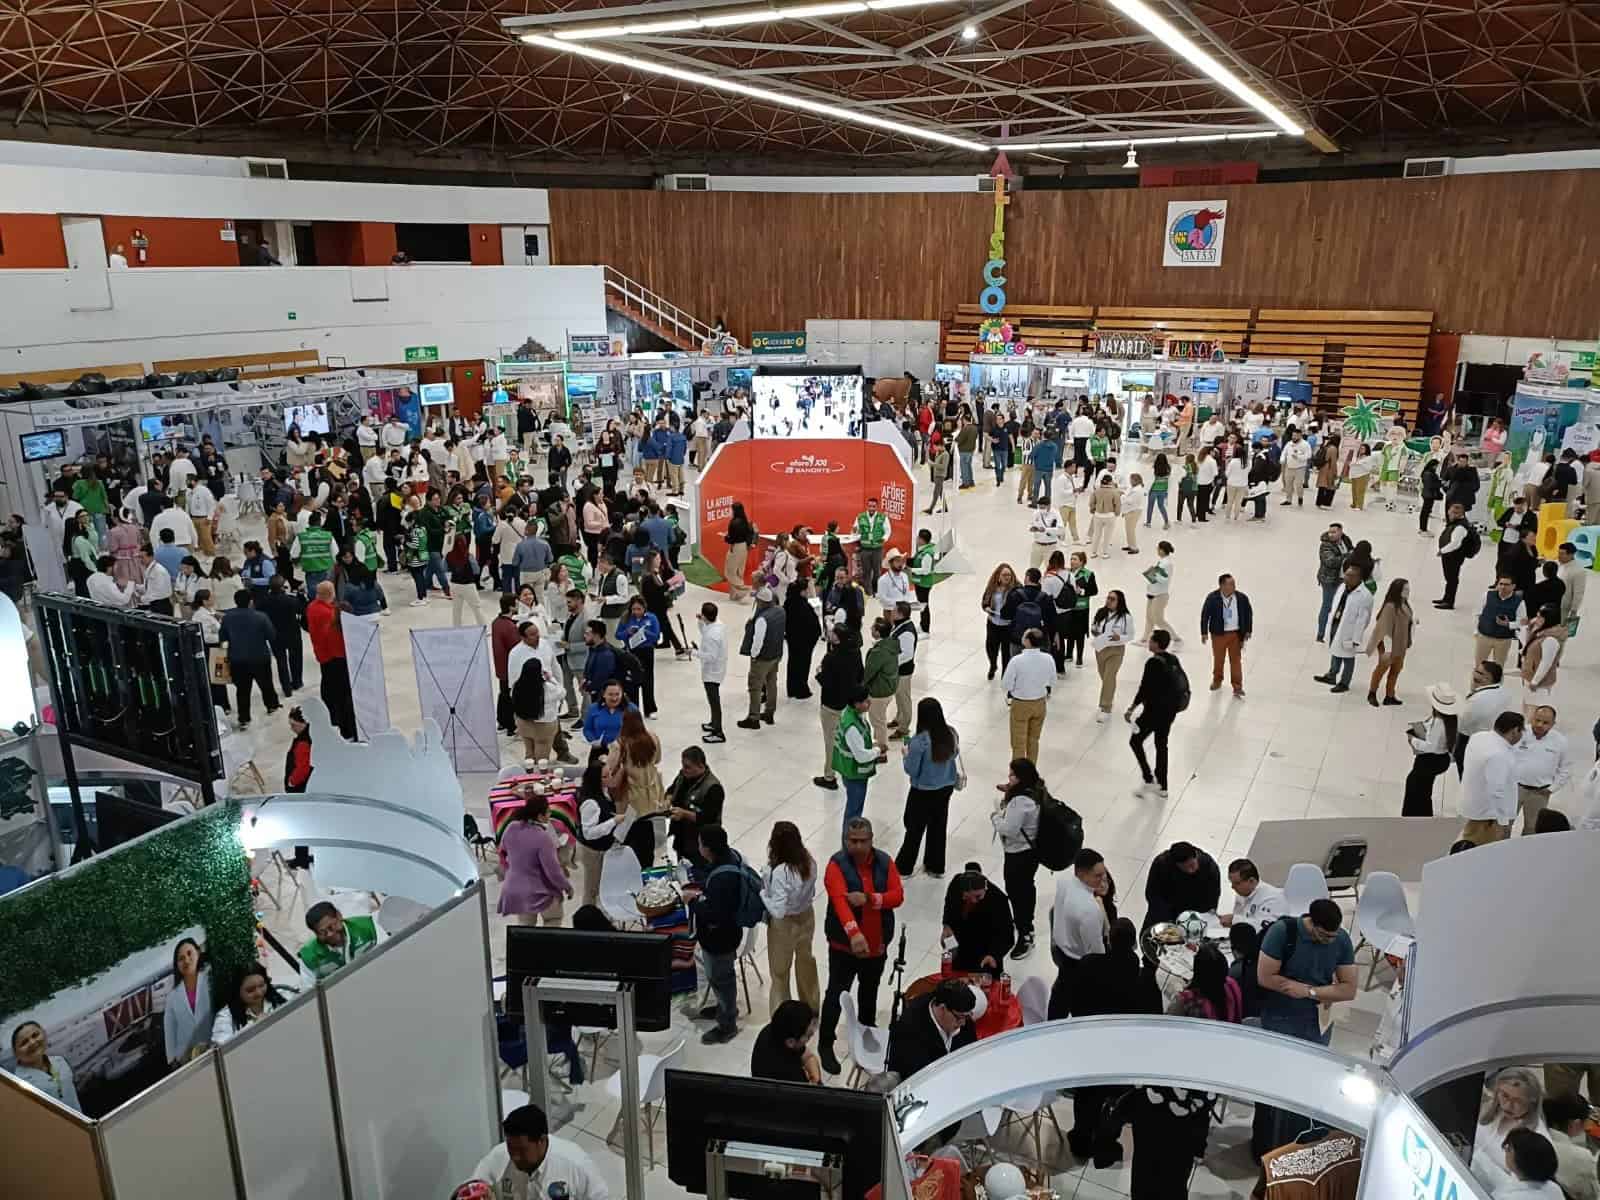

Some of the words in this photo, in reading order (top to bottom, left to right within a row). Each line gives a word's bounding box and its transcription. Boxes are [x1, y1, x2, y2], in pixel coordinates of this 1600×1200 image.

[1099, 339, 1146, 355] NAYARIT
[881, 485, 905, 502] AFORE
[881, 498, 905, 515] FUERTE
